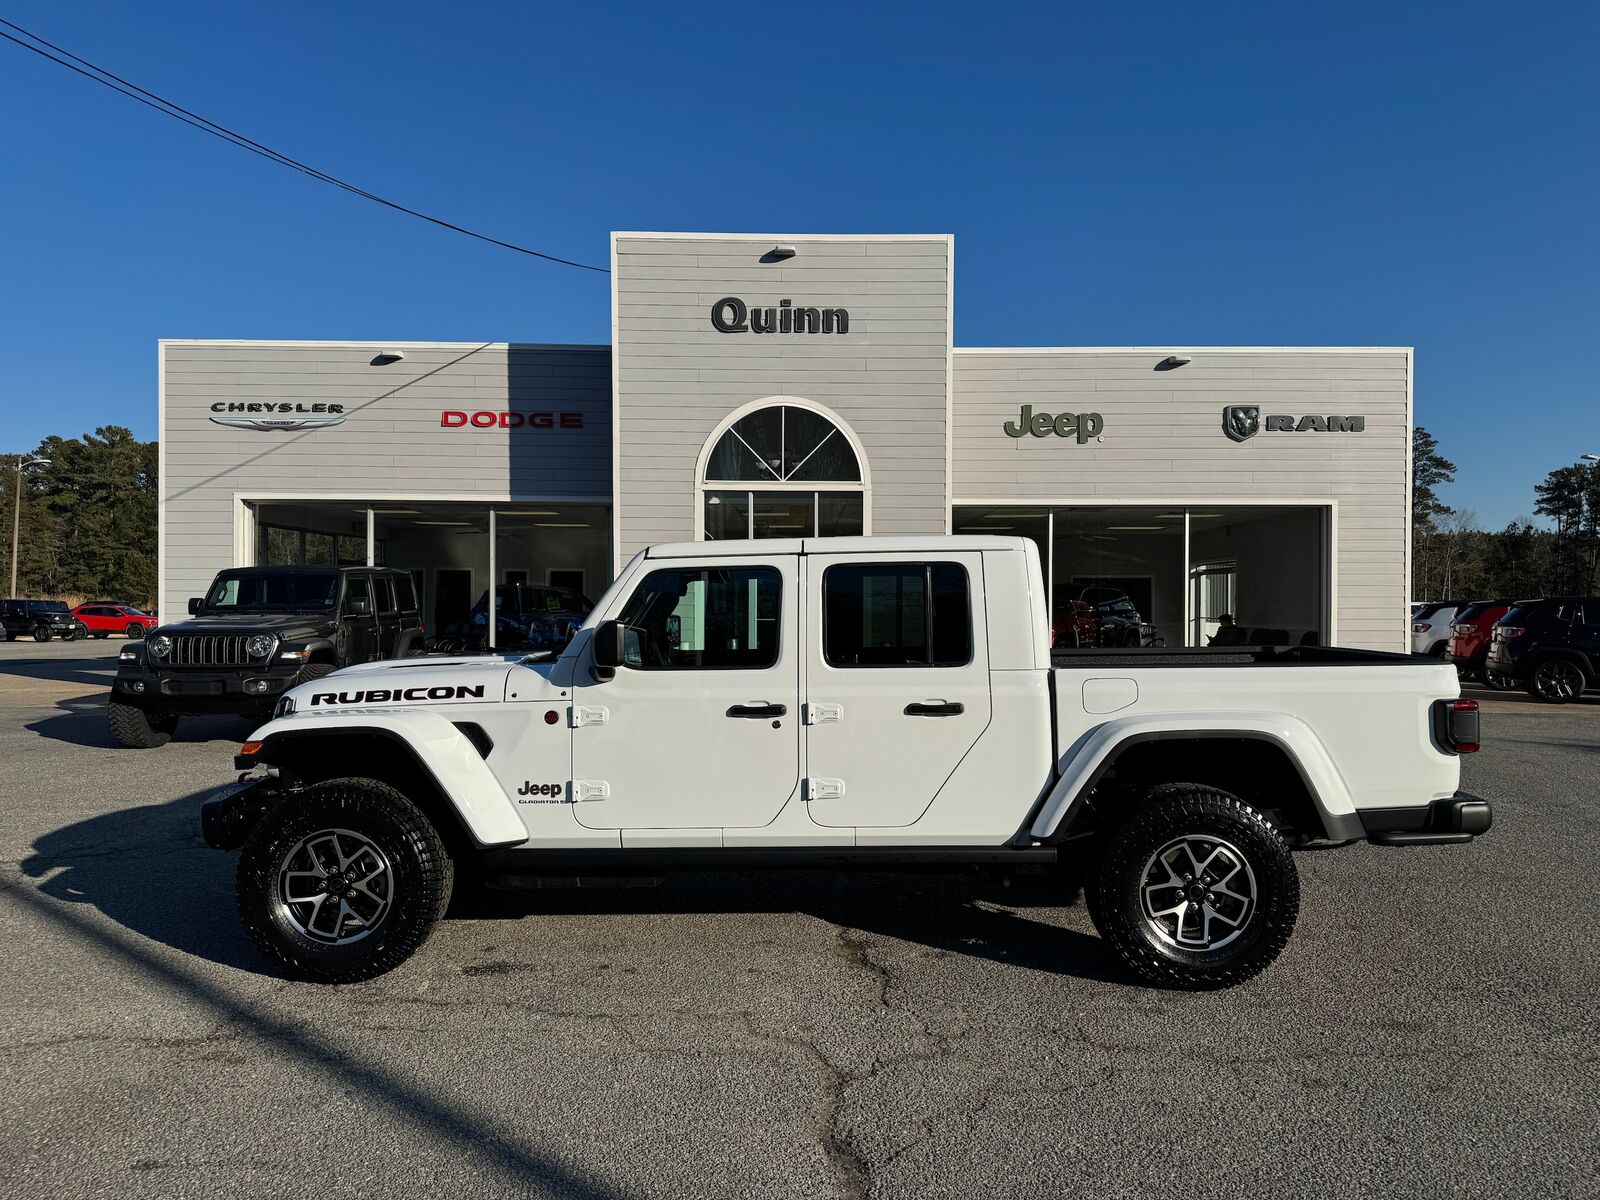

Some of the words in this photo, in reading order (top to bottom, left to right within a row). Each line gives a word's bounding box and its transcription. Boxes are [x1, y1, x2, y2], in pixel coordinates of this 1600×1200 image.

[711, 297, 849, 334] Quinn
[210, 402, 344, 413] CHRYSLER
[441, 411, 583, 429] DODGE
[1004, 404, 1104, 444] Jeep
[1265, 415, 1365, 432] RAM
[310, 685, 485, 706] RUBICON
[517, 780, 562, 798] Jeep
